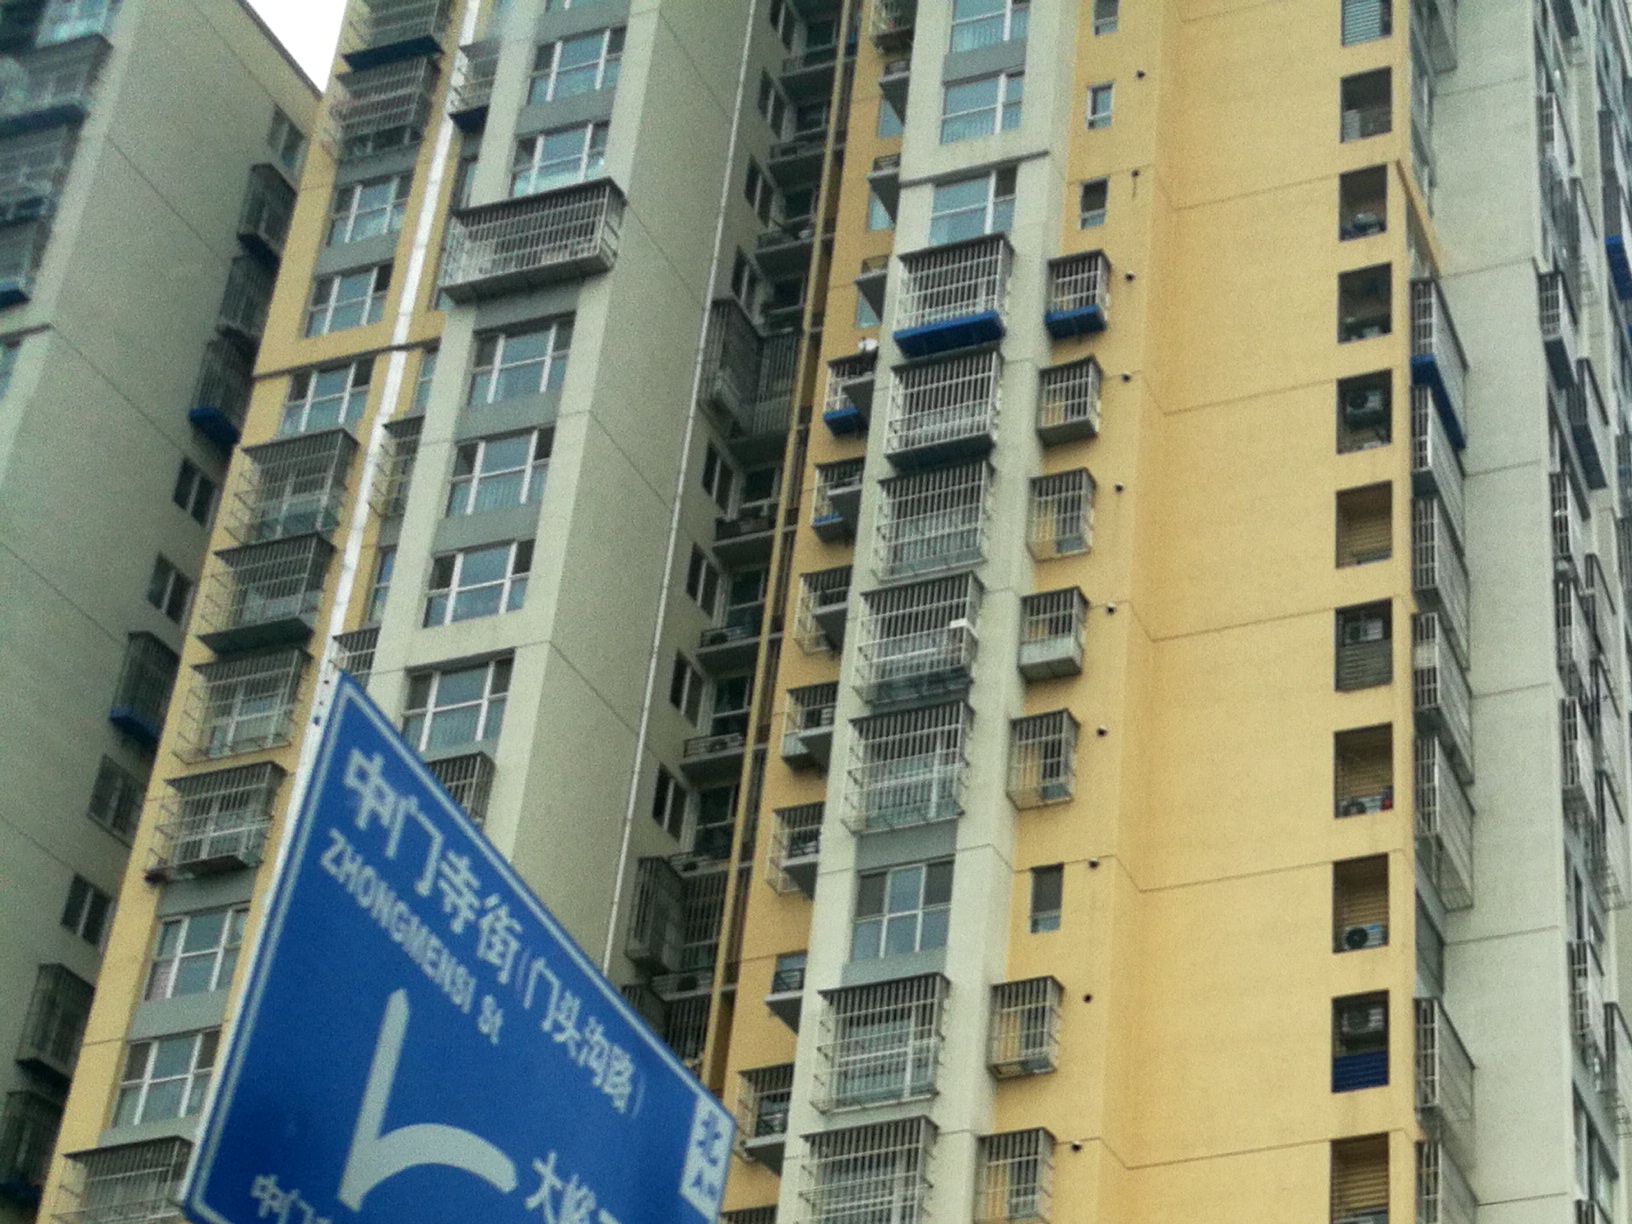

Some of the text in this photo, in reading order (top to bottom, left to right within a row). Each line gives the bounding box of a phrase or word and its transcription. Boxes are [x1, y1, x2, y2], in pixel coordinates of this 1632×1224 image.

[320, 828, 504, 1044] ZHONGMENSI St
[697, 1109, 722, 1167] 北
